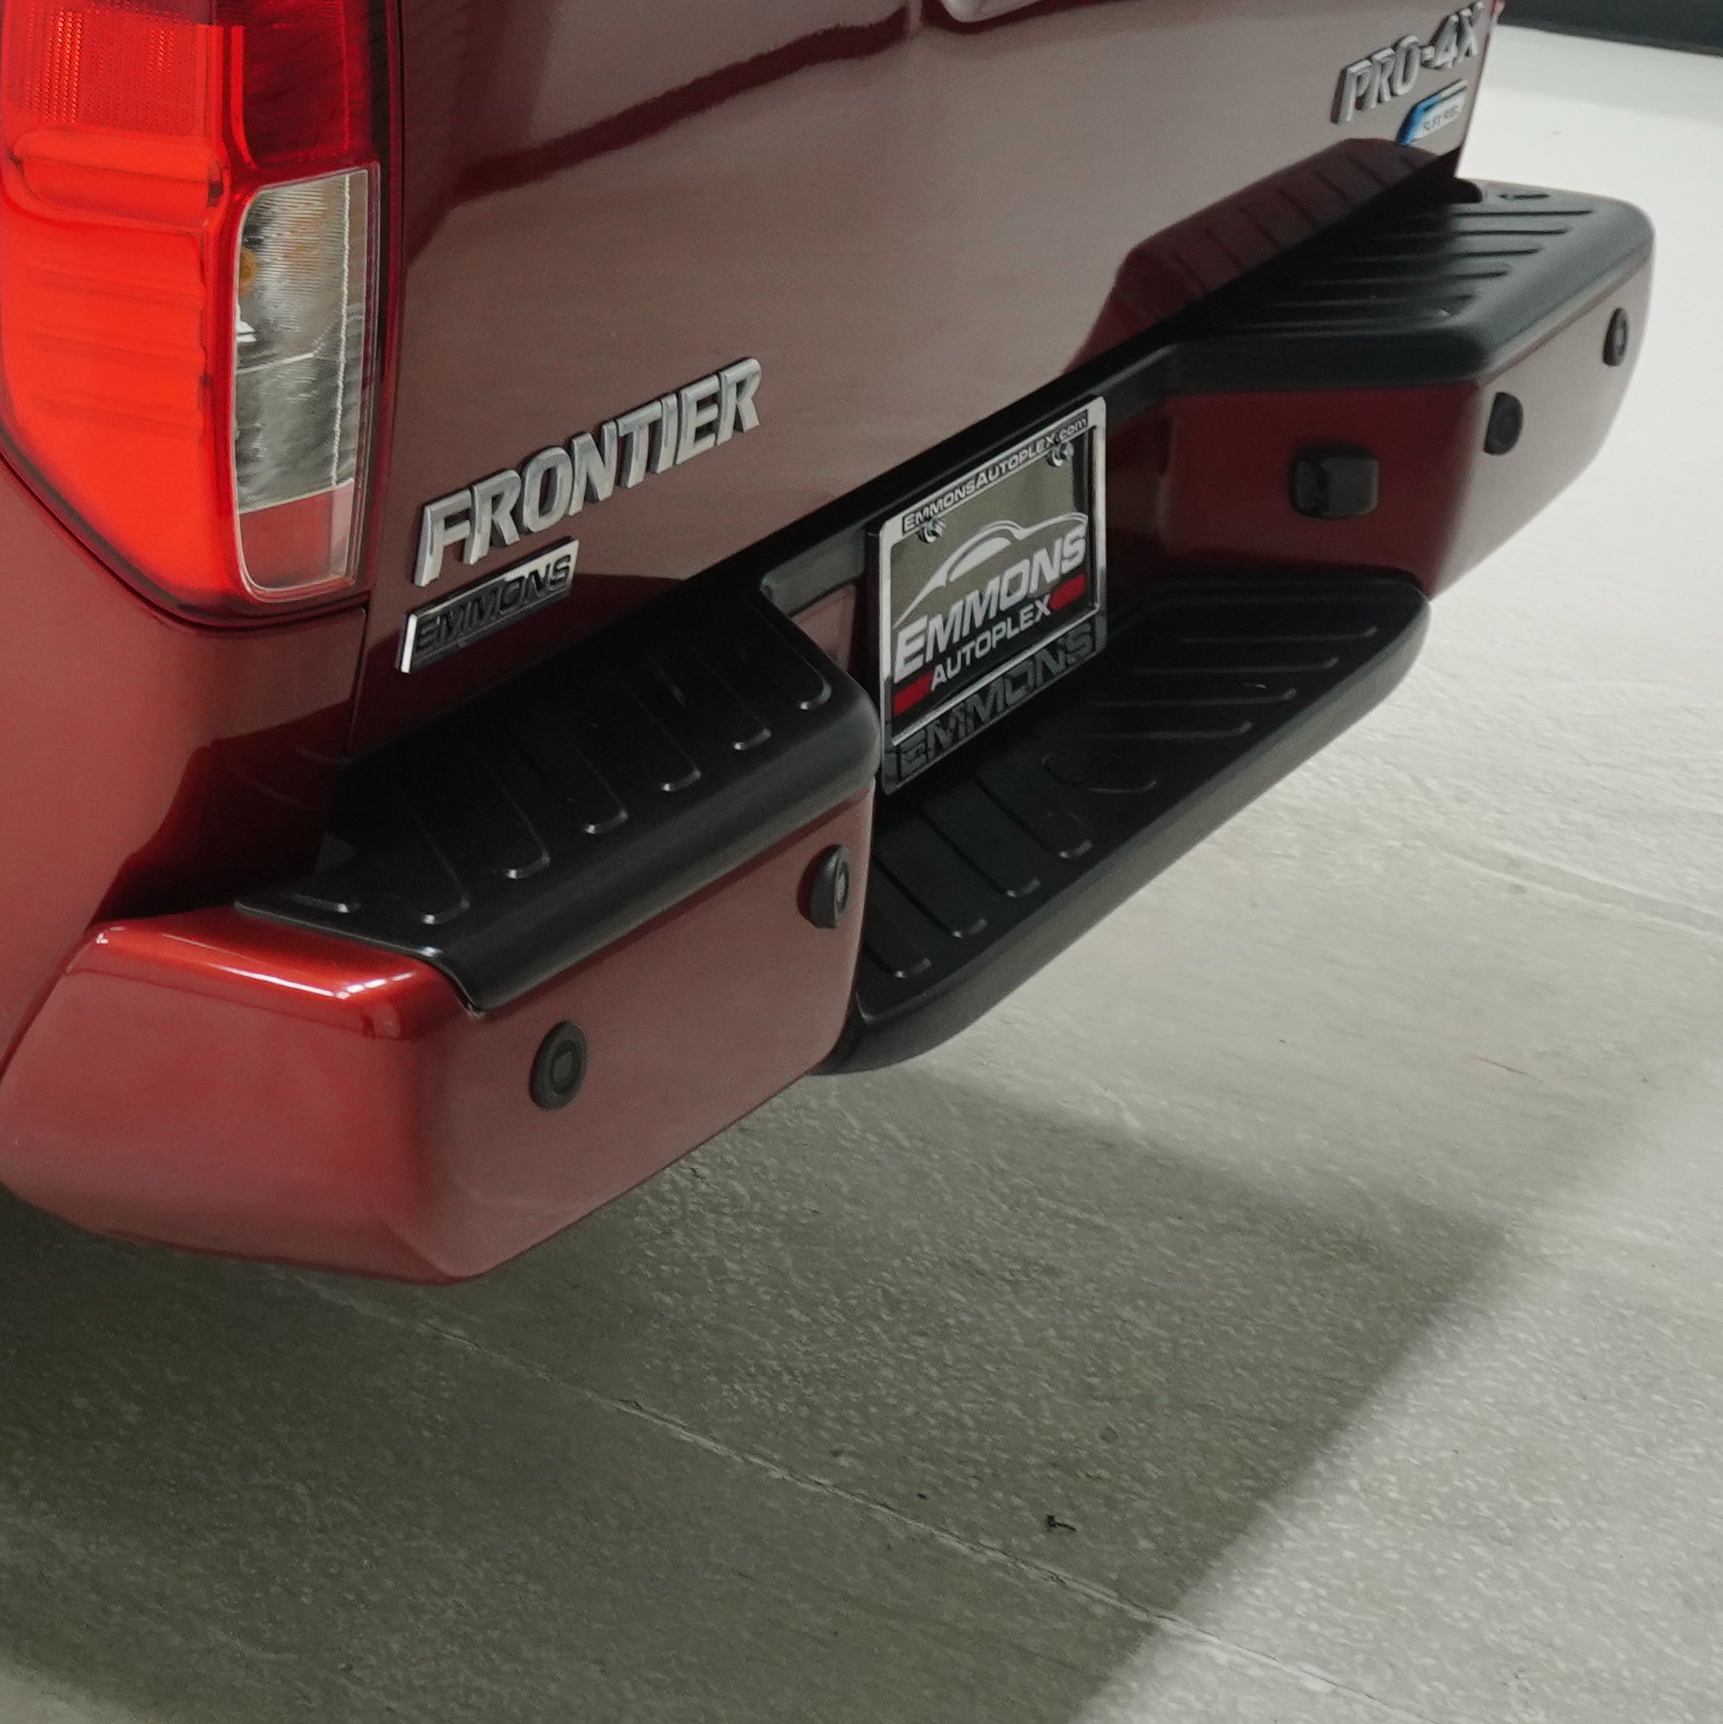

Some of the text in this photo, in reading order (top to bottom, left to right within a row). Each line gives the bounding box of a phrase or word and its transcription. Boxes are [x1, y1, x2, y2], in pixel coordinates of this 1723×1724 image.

[1331, 0, 1485, 124] PRO-4X
[413, 357, 764, 587] FRONTIER
[416, 553, 573, 652] EMMONS
[893, 522, 1088, 684] EMMONS
[930, 593, 1053, 692] AUTOPLEX
[899, 624, 1093, 770] EMMONS
